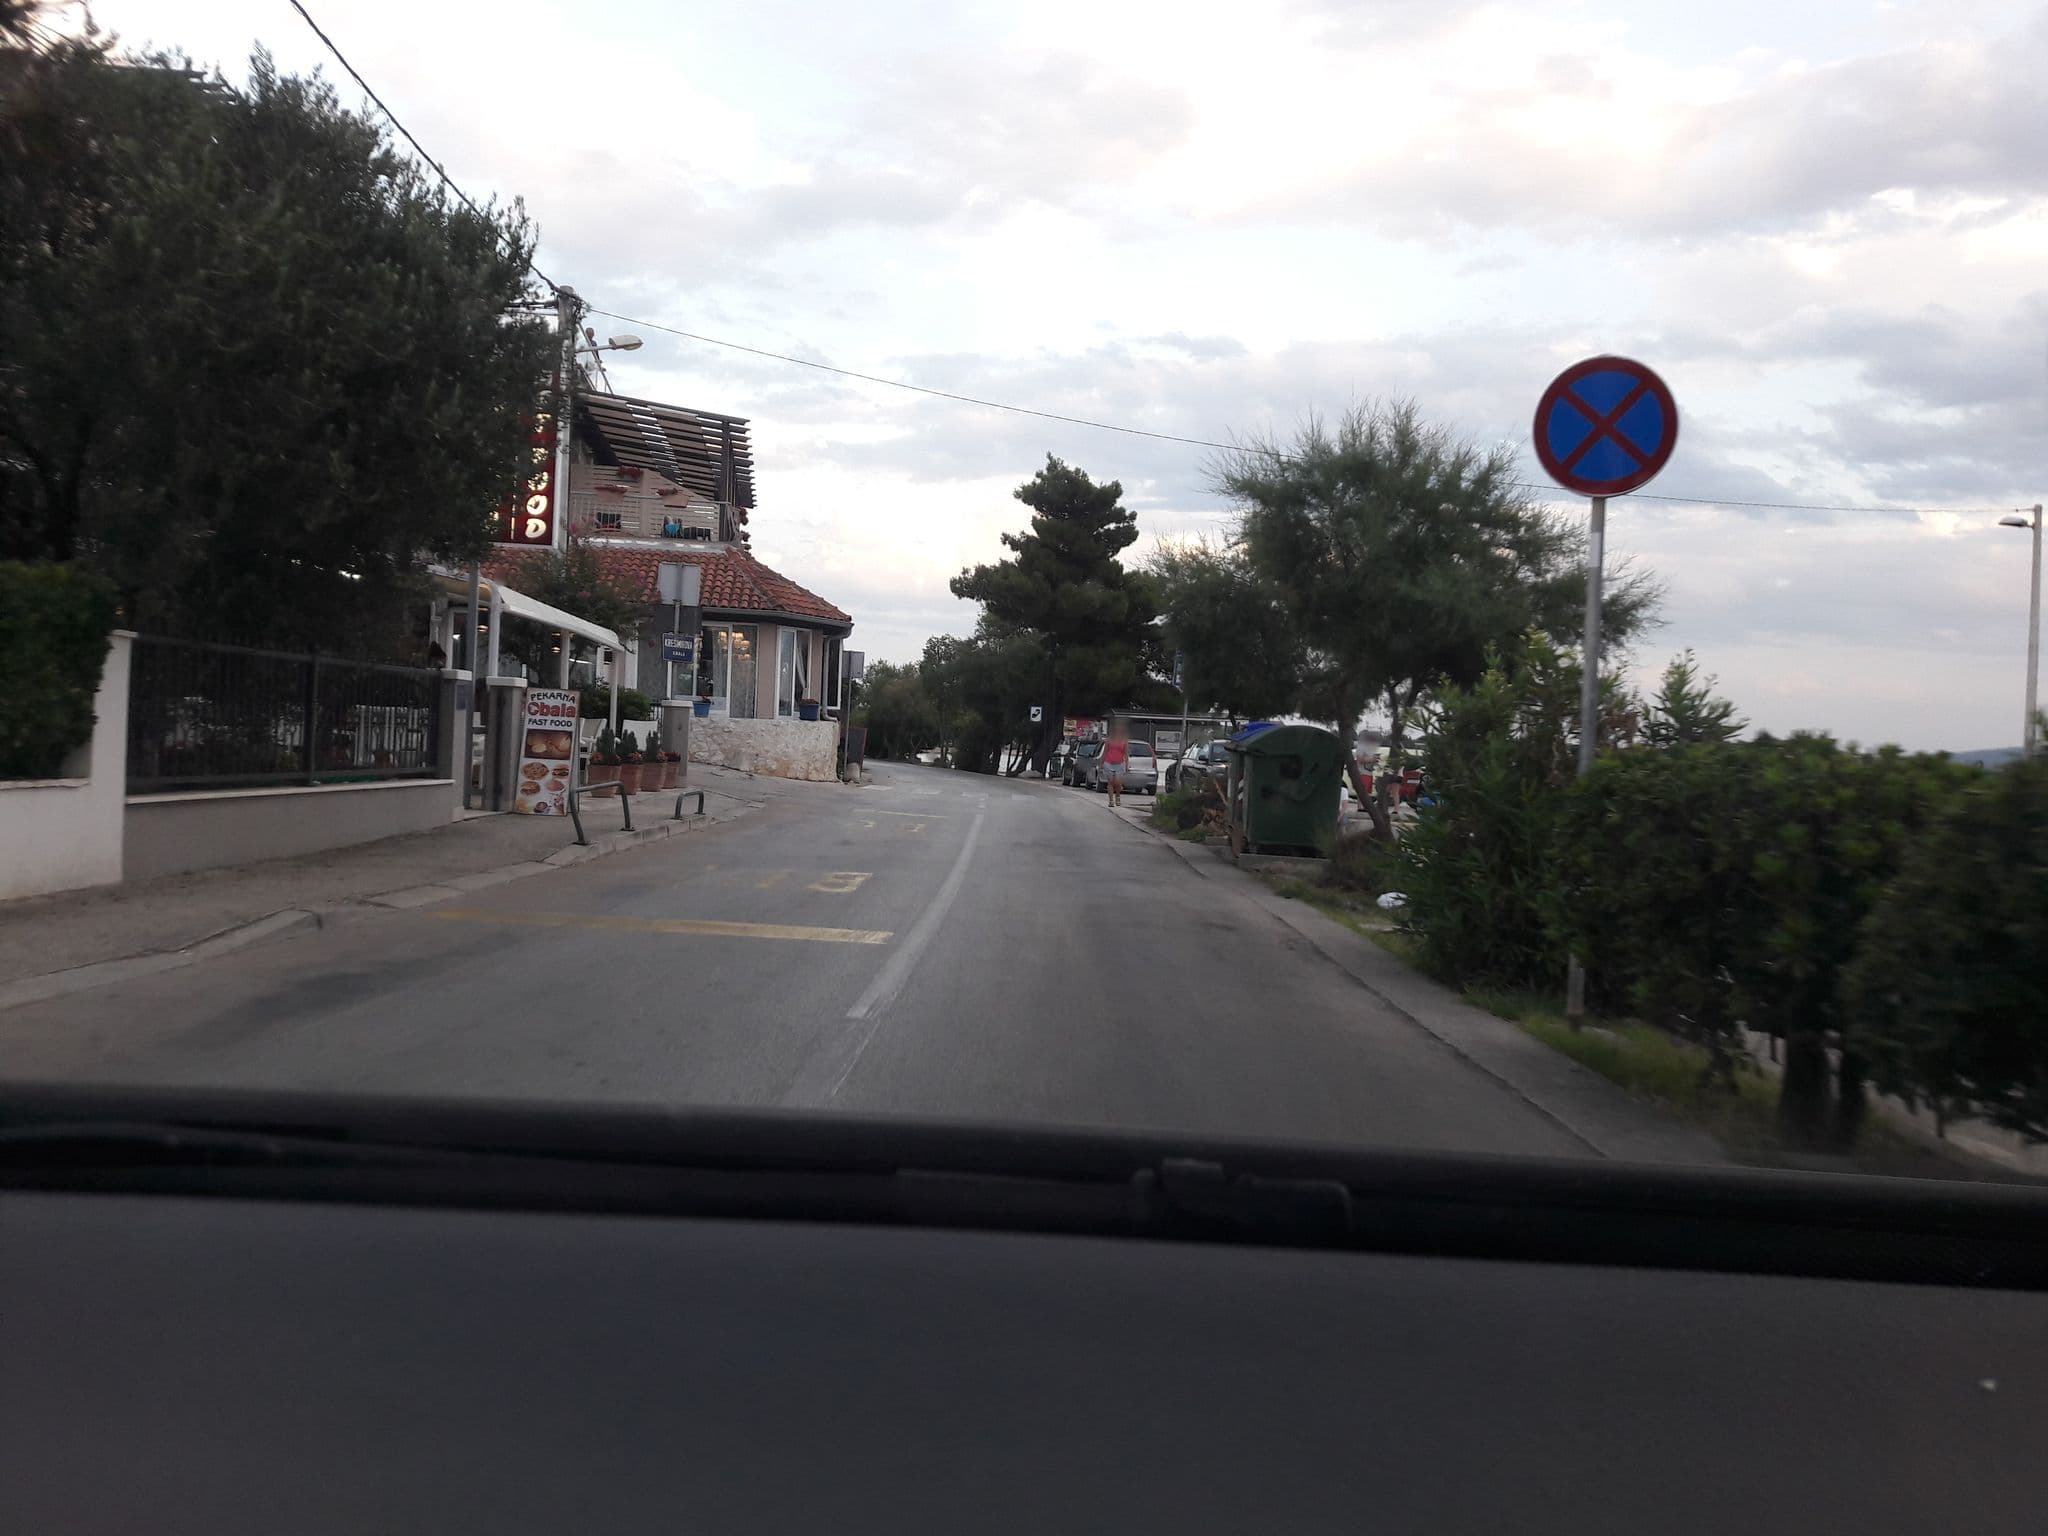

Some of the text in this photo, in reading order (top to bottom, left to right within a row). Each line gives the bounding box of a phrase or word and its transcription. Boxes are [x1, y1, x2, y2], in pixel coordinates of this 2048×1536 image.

[530, 692, 576, 704] PEKARNA
[528, 718, 573, 728] FAST FOOD
